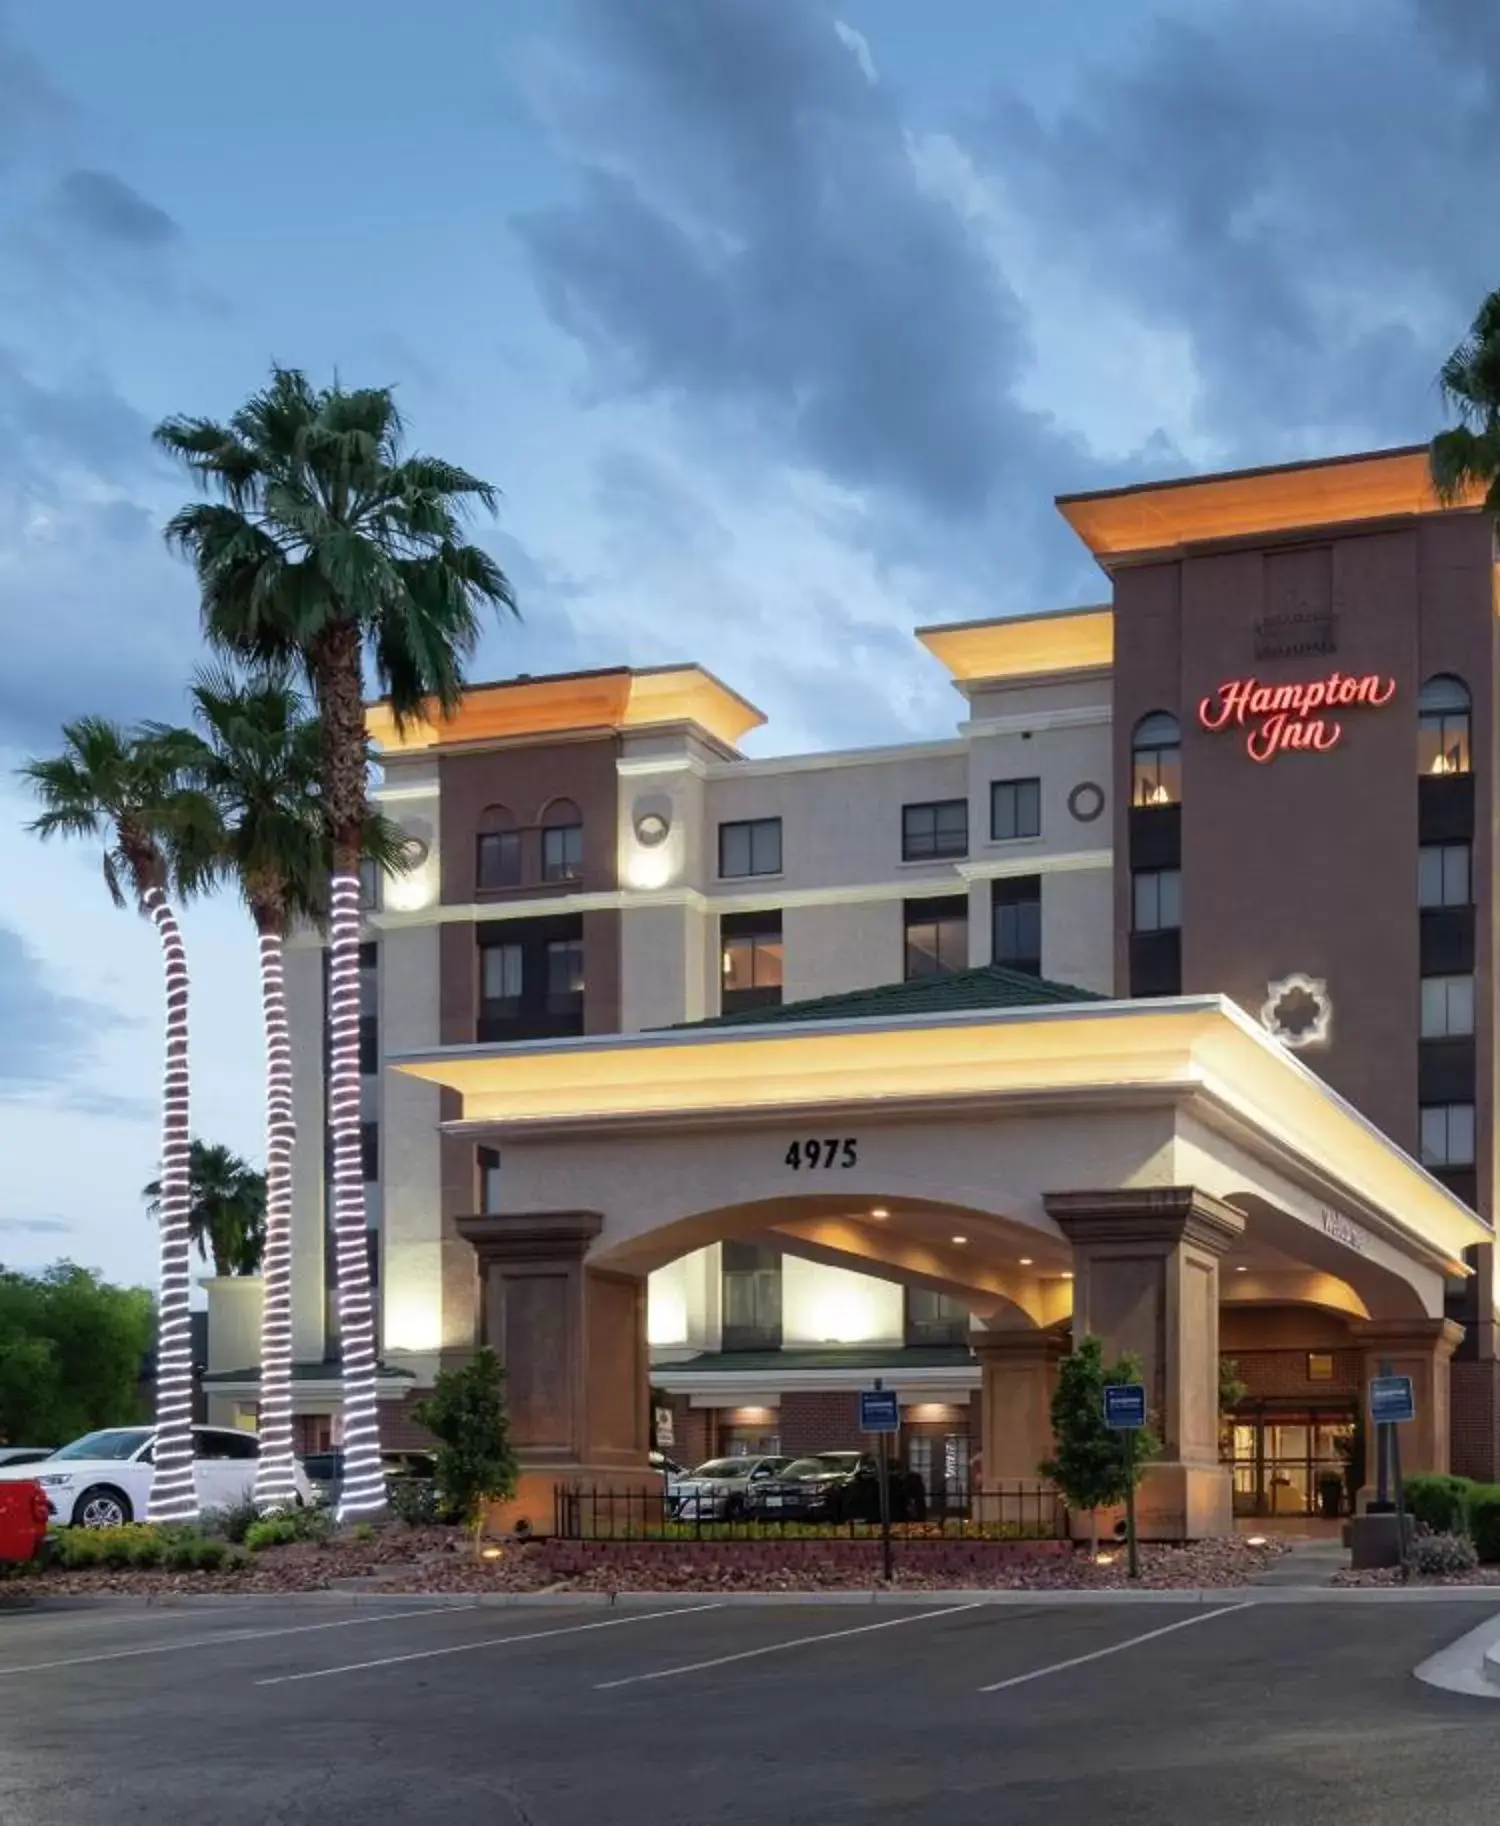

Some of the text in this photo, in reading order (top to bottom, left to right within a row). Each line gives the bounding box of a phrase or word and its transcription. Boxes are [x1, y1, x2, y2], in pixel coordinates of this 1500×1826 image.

[1199, 671, 1396, 729] Hampton
[1247, 712, 1341, 763] Inn
[785, 1138, 857, 1171] 4975
